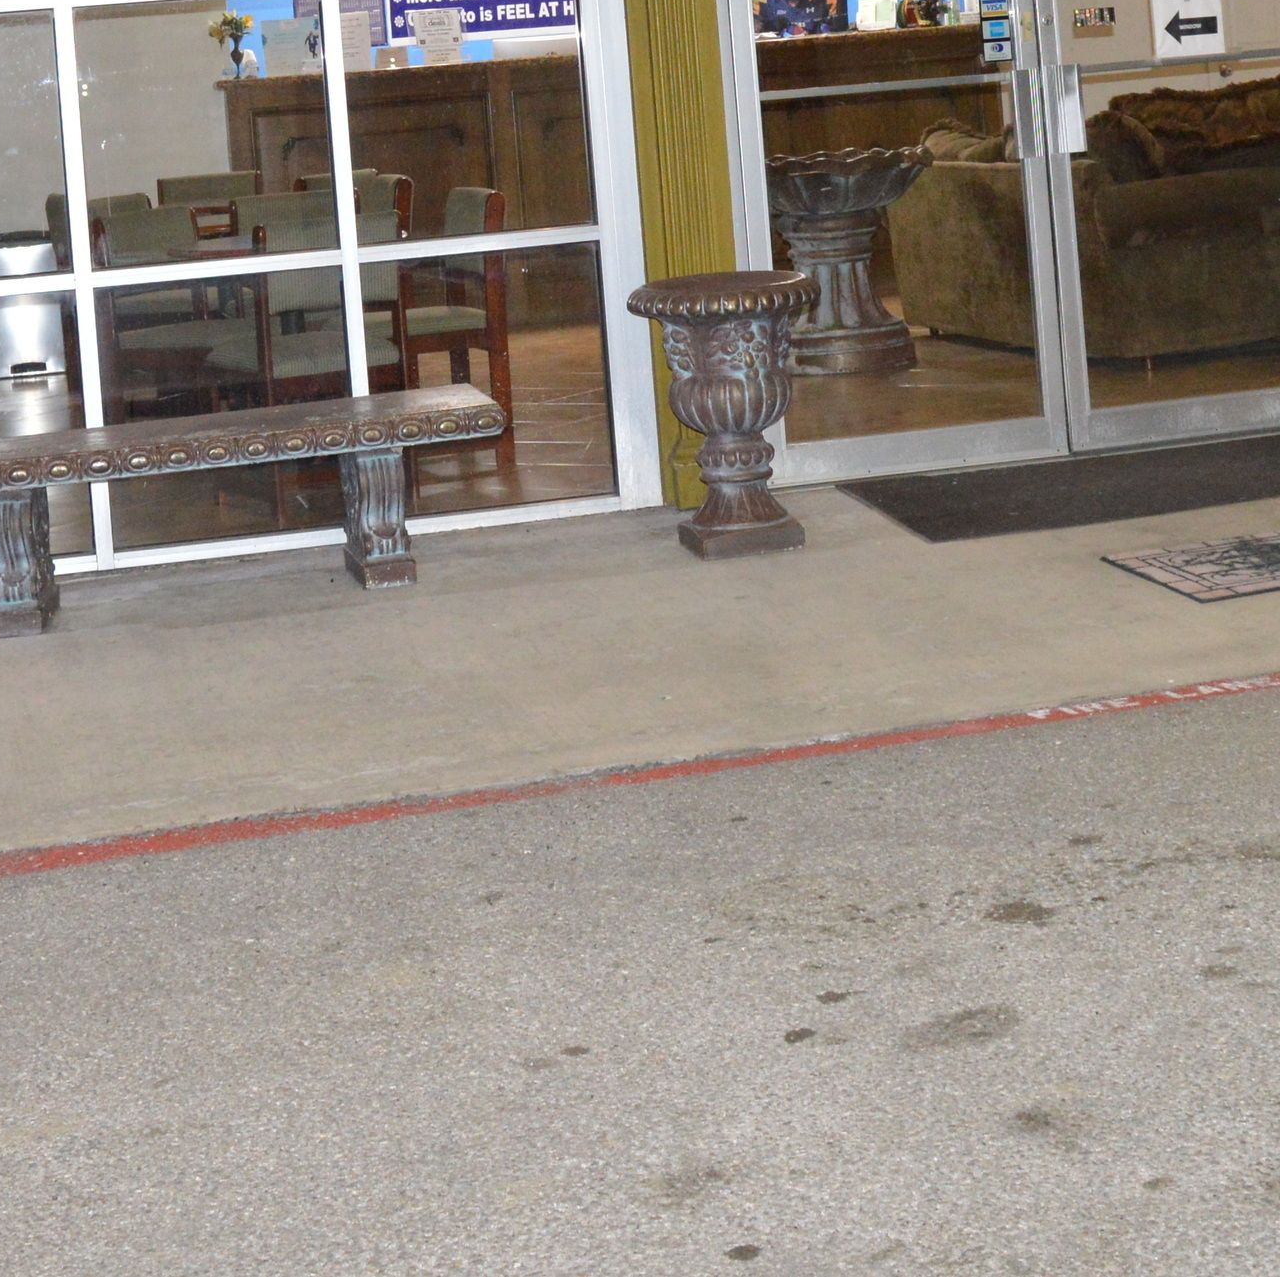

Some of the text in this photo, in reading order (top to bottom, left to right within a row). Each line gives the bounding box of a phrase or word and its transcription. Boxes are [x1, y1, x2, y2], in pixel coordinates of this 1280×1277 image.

[479, 6, 493, 22] is
[496, 3, 535, 20] FEEL
[538, 1, 559, 18] AT
